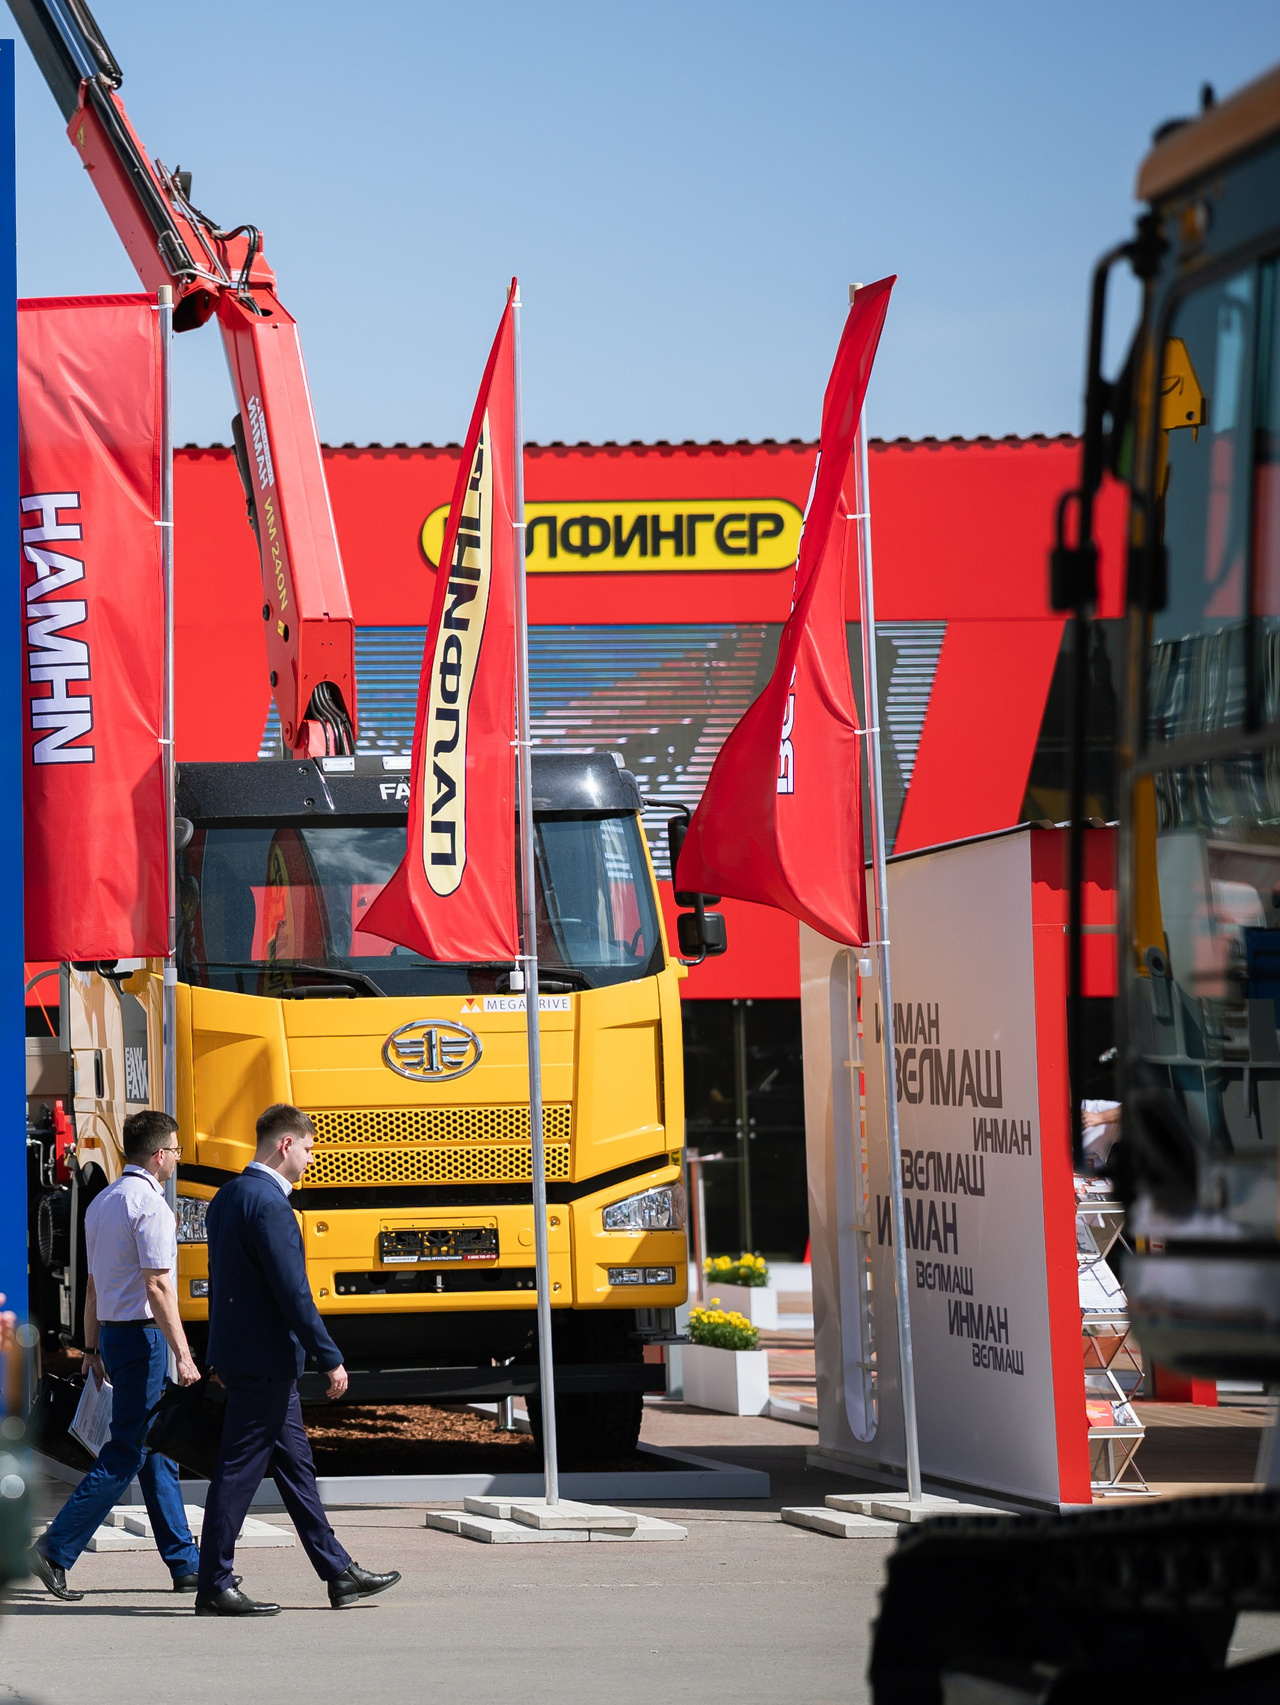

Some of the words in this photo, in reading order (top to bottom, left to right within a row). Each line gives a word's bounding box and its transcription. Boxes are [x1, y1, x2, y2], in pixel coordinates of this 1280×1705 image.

[379, 783, 411, 800] FA
[487, 999, 568, 1010] MEGARIVE
[972, 1117, 1032, 1156] ИНМАН
[900, 1148, 986, 1197] ВЕЛМАШ
[876, 1194, 959, 1255] ИМАН
[915, 1260, 974, 1296] ВЕЛМАШ
[947, 1298, 1010, 1345] ИНМАН
[972, 1342, 1024, 1376] ВЕЛМАШ
